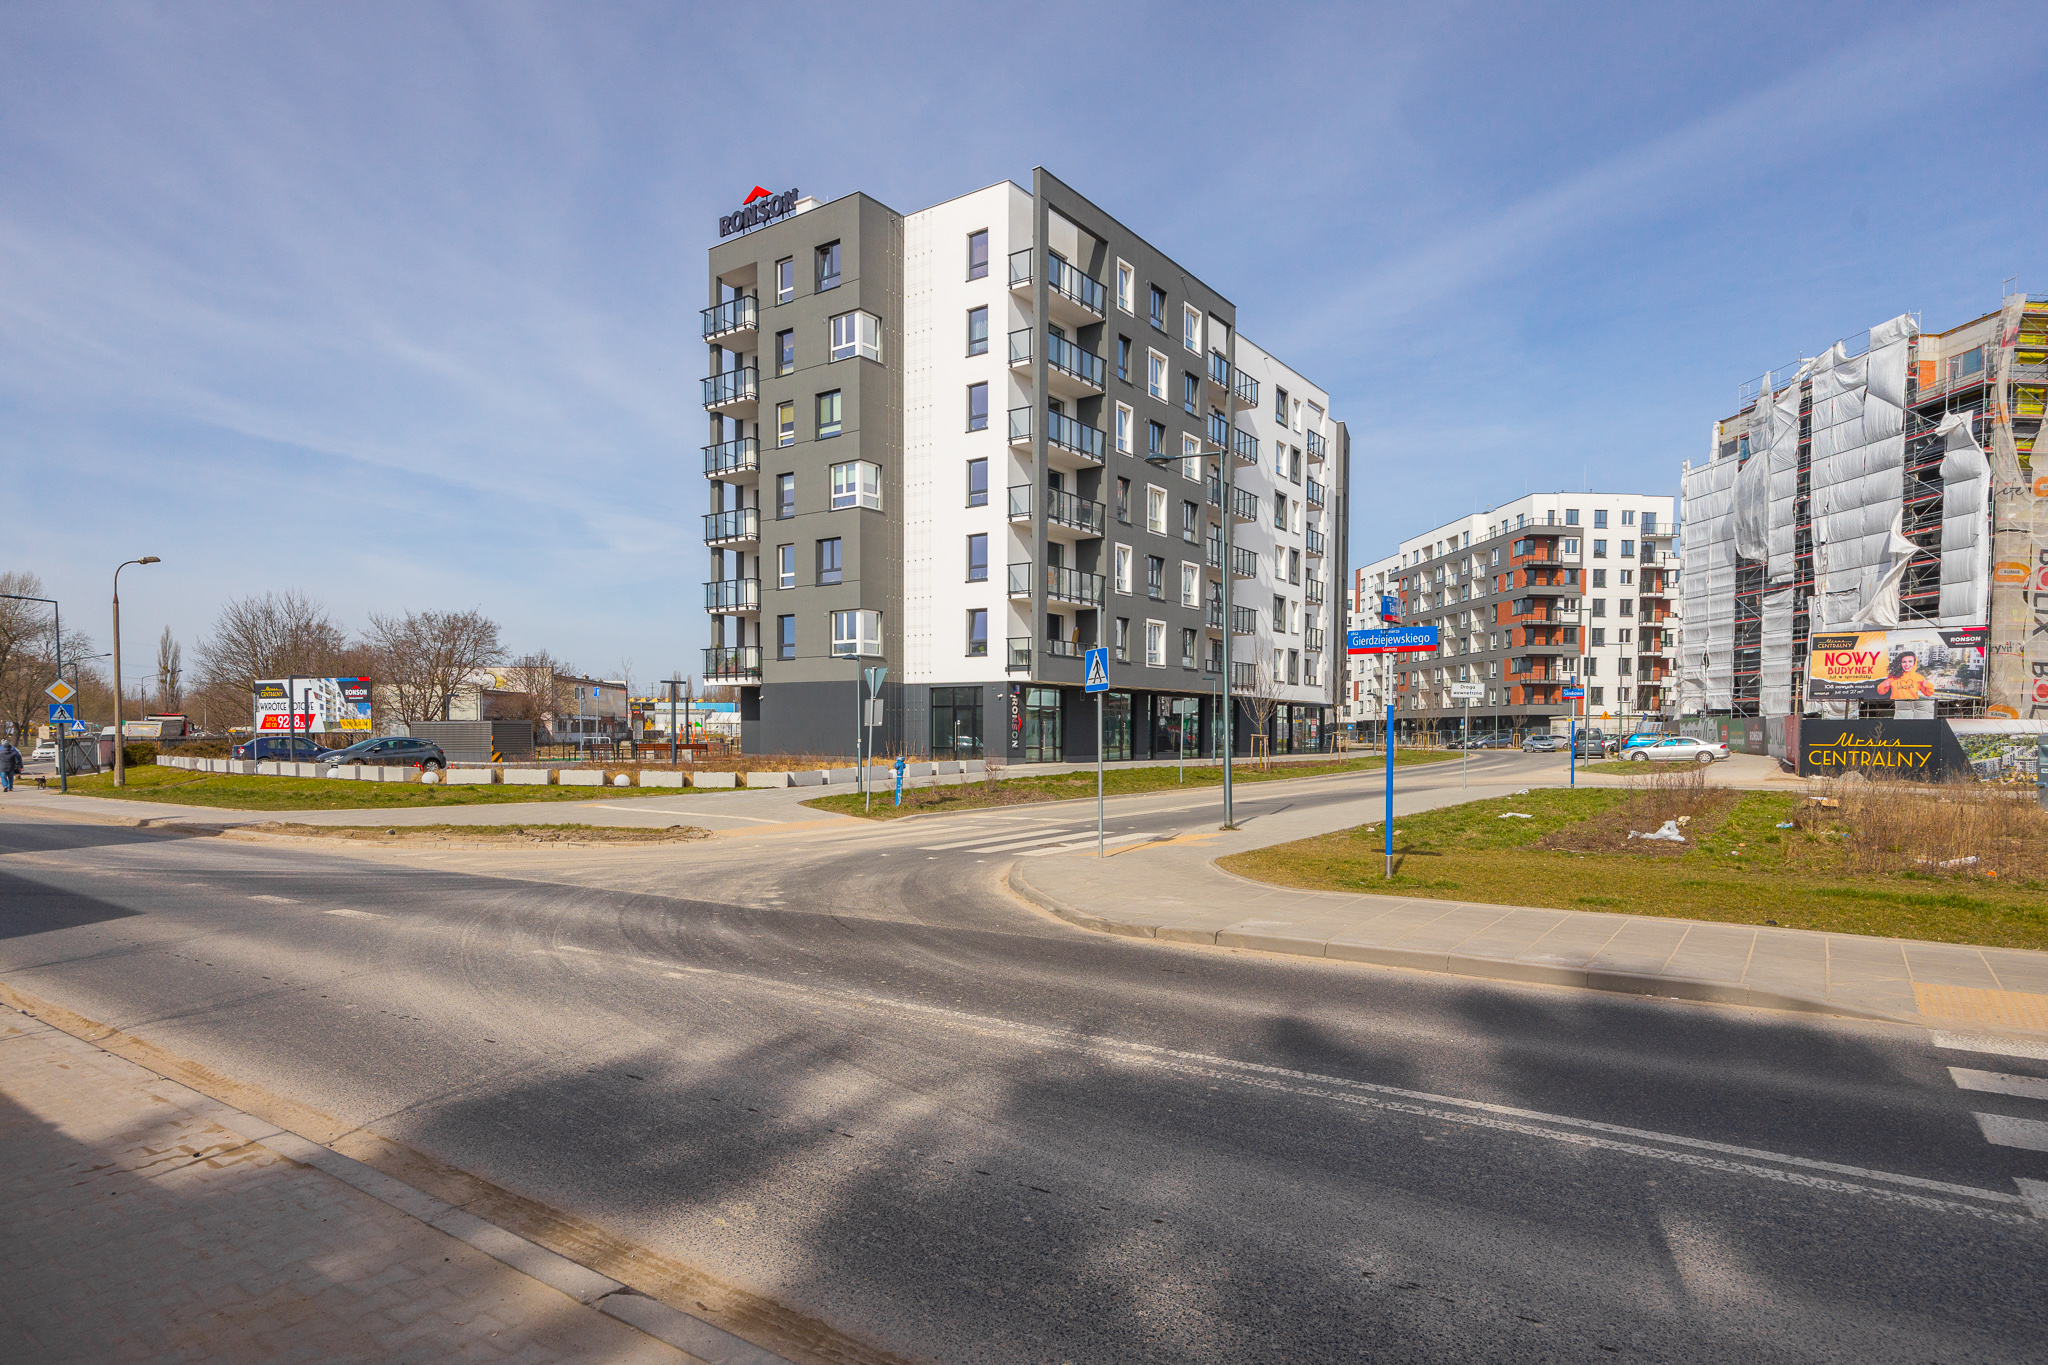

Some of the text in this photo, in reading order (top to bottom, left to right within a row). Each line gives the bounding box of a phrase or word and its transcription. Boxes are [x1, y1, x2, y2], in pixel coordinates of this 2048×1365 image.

[719, 188, 799, 237] RONSON
[1352, 633, 1430, 647] Gierdziejewskiego
[1824, 651, 1880, 667] NOWY
[1828, 666, 1874, 675] BUDYNEK
[289, 702, 314, 711] OTOE
[277, 716, 300, 728] 928
[1011, 698, 1019, 748] RONSON
[1749, 731, 1763, 741] RONSON
[1833, 732, 1902, 747] Ursus
[1808, 750, 1932, 768] CENTRALNY
